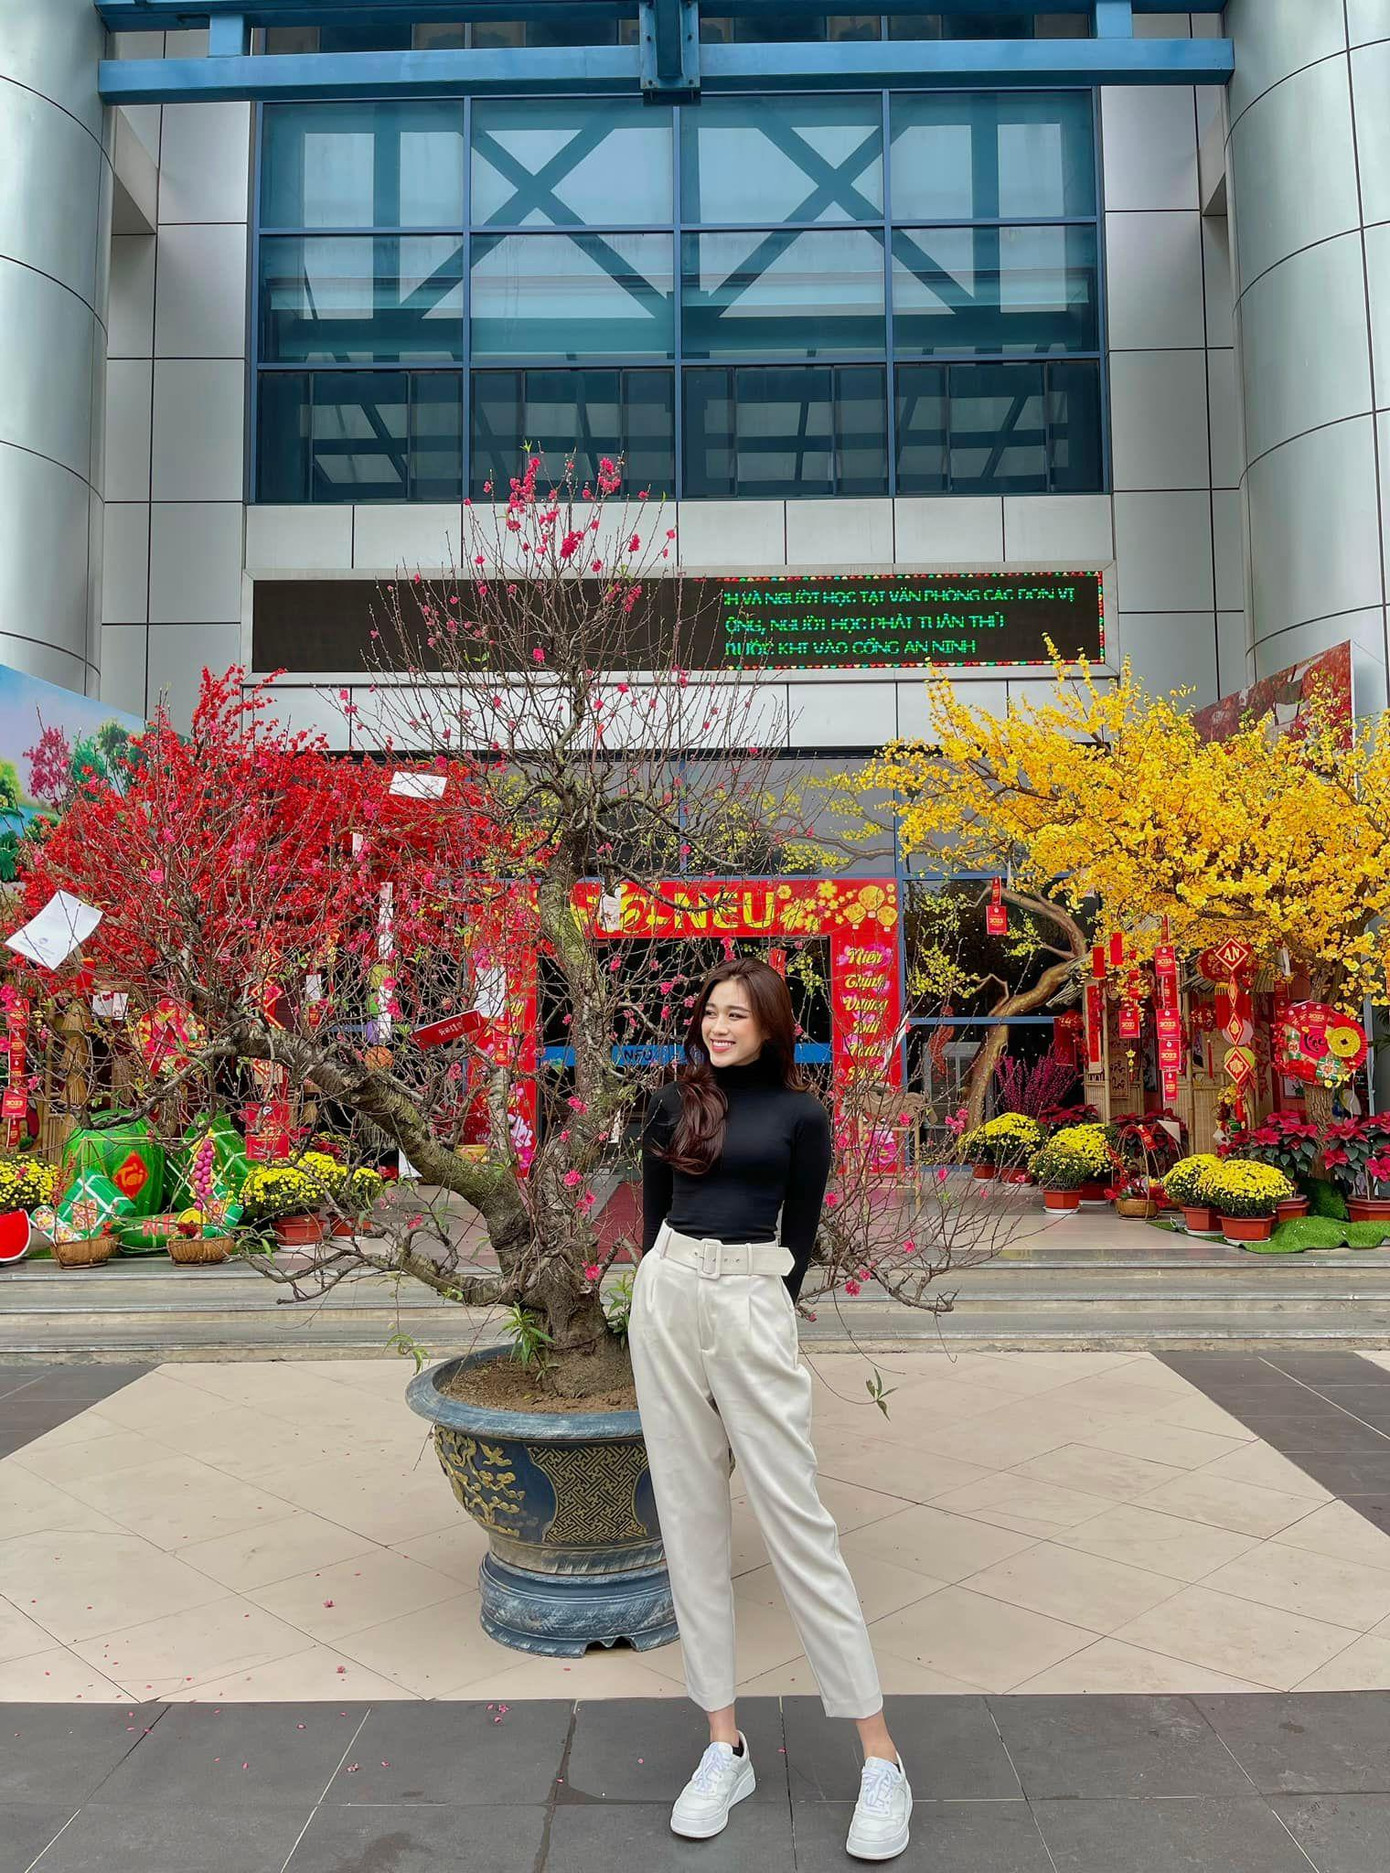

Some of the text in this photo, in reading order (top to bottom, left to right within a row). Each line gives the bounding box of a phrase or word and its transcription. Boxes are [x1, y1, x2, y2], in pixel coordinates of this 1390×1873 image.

[822, 591, 857, 607] HỌC
[888, 587, 921, 602] VĂN
[924, 587, 980, 602] PHÒNG
[983, 587, 1015, 601] CÁC
[1057, 588, 1075, 603] VỊ
[831, 617, 867, 634] HỌC
[812, 638, 849, 654] VÀO
[904, 640, 929, 654] AN
[932, 639, 976, 654] NINH
[1223, 947, 1240, 961] AN
